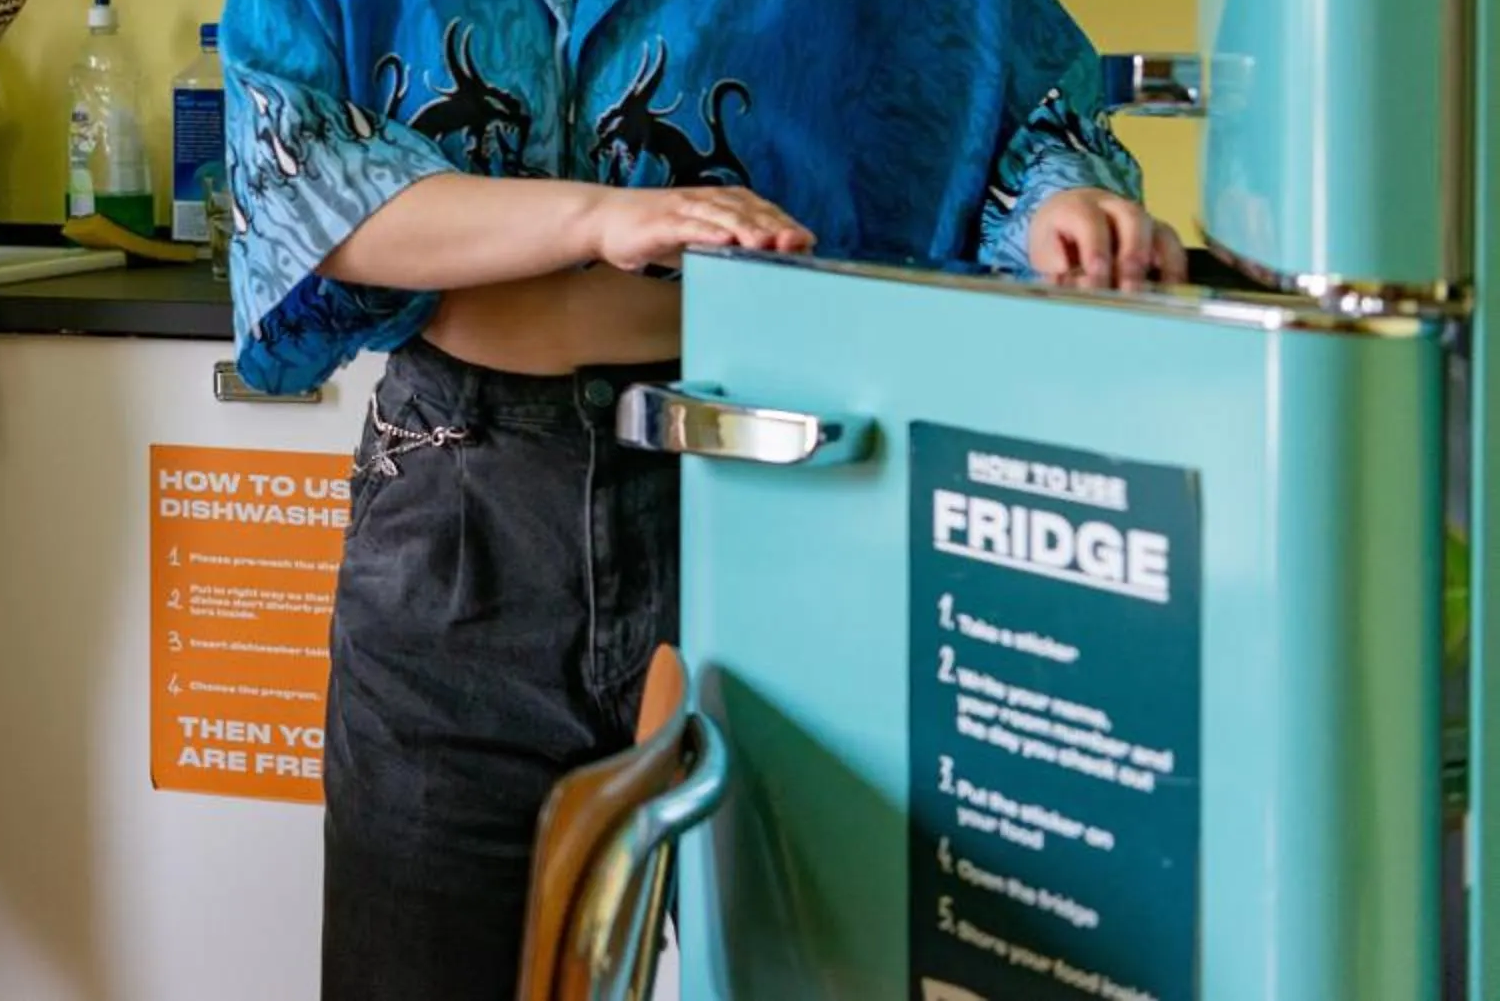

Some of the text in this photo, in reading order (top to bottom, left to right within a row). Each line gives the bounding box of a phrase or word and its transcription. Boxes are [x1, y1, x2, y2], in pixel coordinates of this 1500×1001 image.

[159, 469, 351, 501] HOW TO US
[967, 450, 1029, 488] HOW
[1031, 460, 1068, 496] TO
[160, 497, 352, 529] DISHWASHE
[164, 545, 182, 568] 1
[933, 488, 1170, 599] FRIDGE
[167, 588, 183, 611] 2
[168, 630, 184, 652] 3
[957, 612, 999, 644] Take
[1014, 631, 1081, 664] sticker
[167, 673, 183, 697] 4
[177, 715, 325, 749] THEN YO
[177, 746, 323, 780] ARE FRE
[1131, 744, 1175, 774] and
[956, 778, 988, 808] Put
[987, 790, 1020, 819] the
[1019, 801, 1085, 840] sticker
[1084, 825, 1116, 852] on
[956, 857, 1005, 893] Open
[1005, 877, 1038, 908] the
[1037, 887, 1101, 929] fridge
[956, 919, 1009, 958] Store
[1008, 942, 1053, 973] your
[1052, 958, 1102, 995] food
